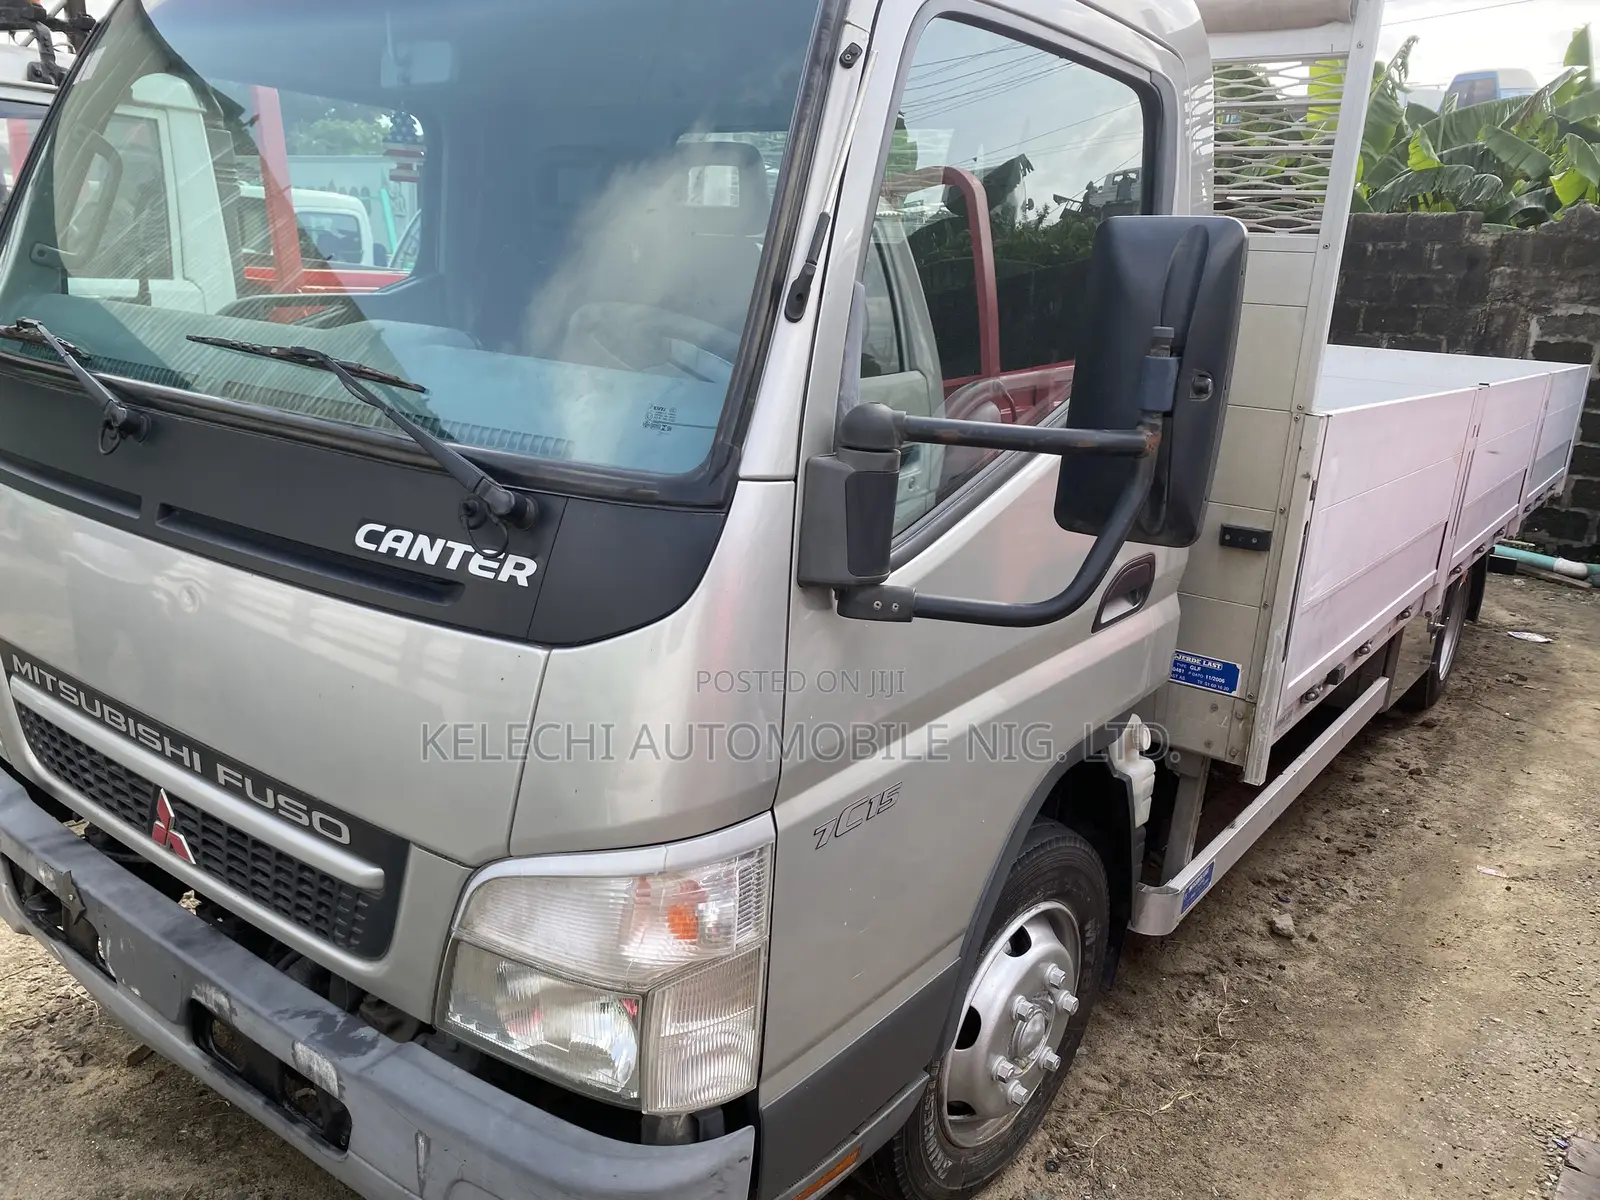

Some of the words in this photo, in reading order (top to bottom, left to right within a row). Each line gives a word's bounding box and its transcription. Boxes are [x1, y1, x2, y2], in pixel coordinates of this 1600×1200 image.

[354, 523, 538, 587] CANTER
[1202, 659, 1222, 670] LAST
[12, 653, 202, 774] MITSUBISHI
[216, 762, 351, 845] FUSO
[813, 781, 903, 850] 7C15
